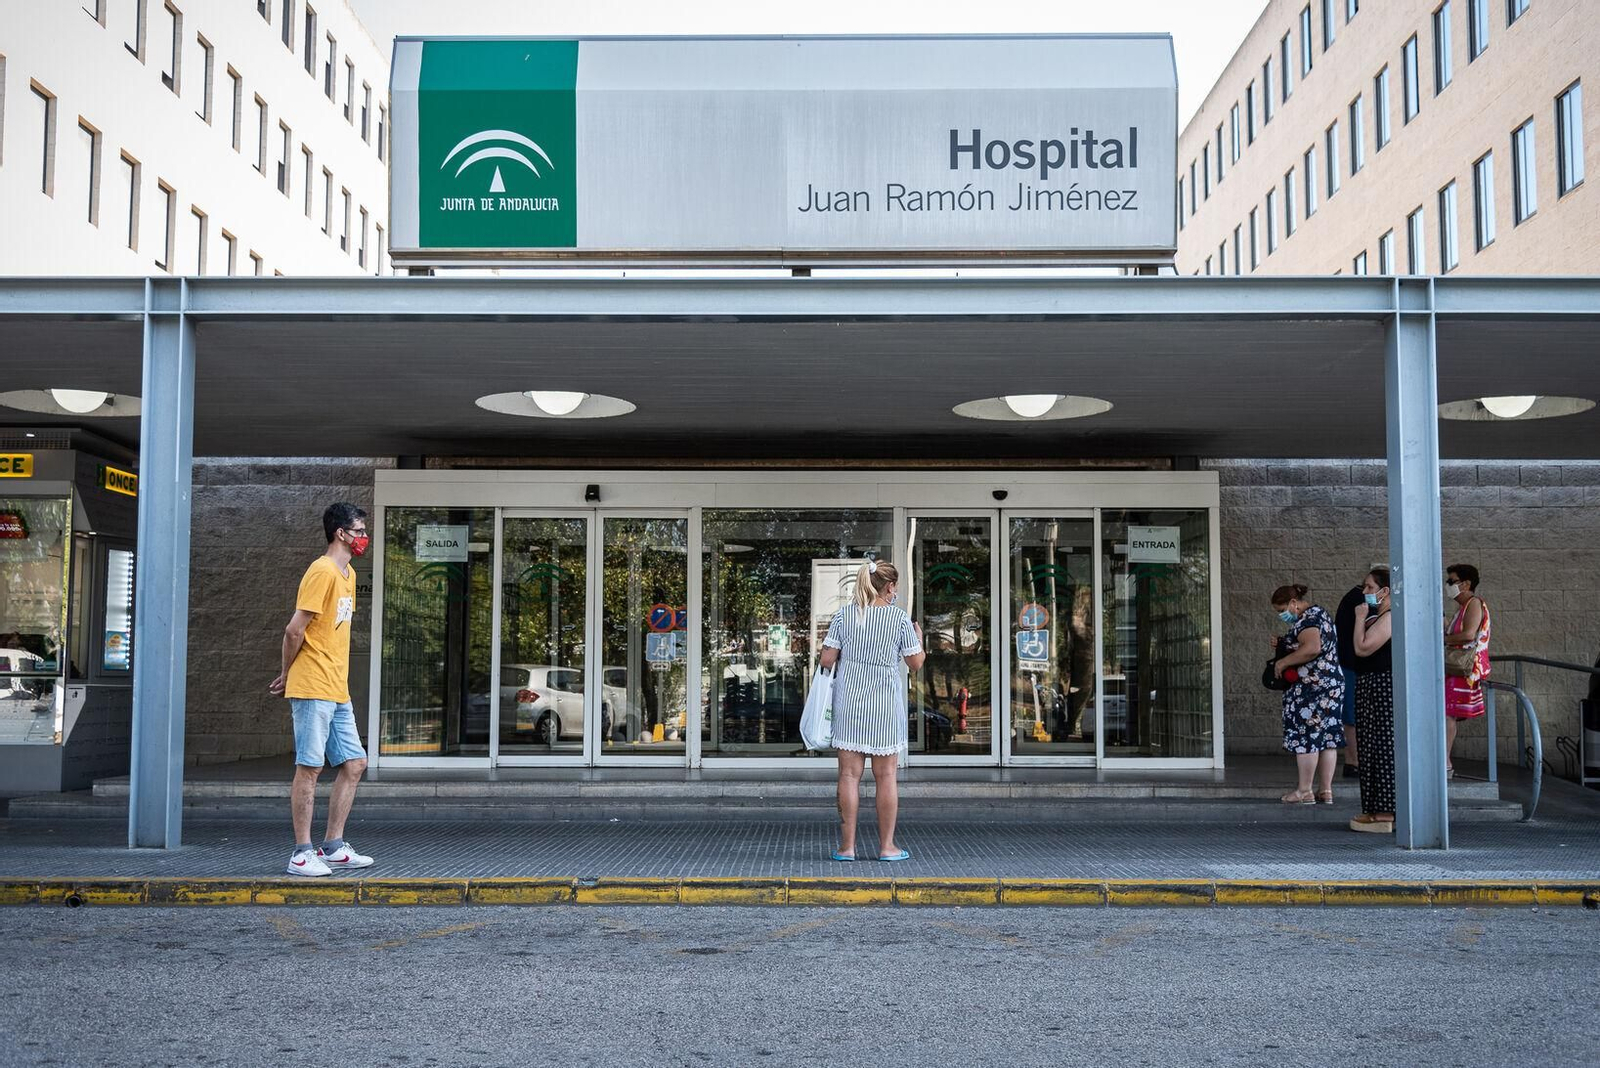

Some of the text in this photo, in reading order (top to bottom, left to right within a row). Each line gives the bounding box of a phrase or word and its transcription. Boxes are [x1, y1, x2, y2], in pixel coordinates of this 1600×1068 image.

[949, 126, 1138, 181] Hospital
[440, 197, 560, 211] JUNTA DE ANDALUCIA
[797, 182, 1138, 212] Juan Ramón Jiménez
[109, 471, 135, 492] ONCE
[425, 539, 459, 548] SALIDA
[1132, 540, 1176, 549] ENTRADA
